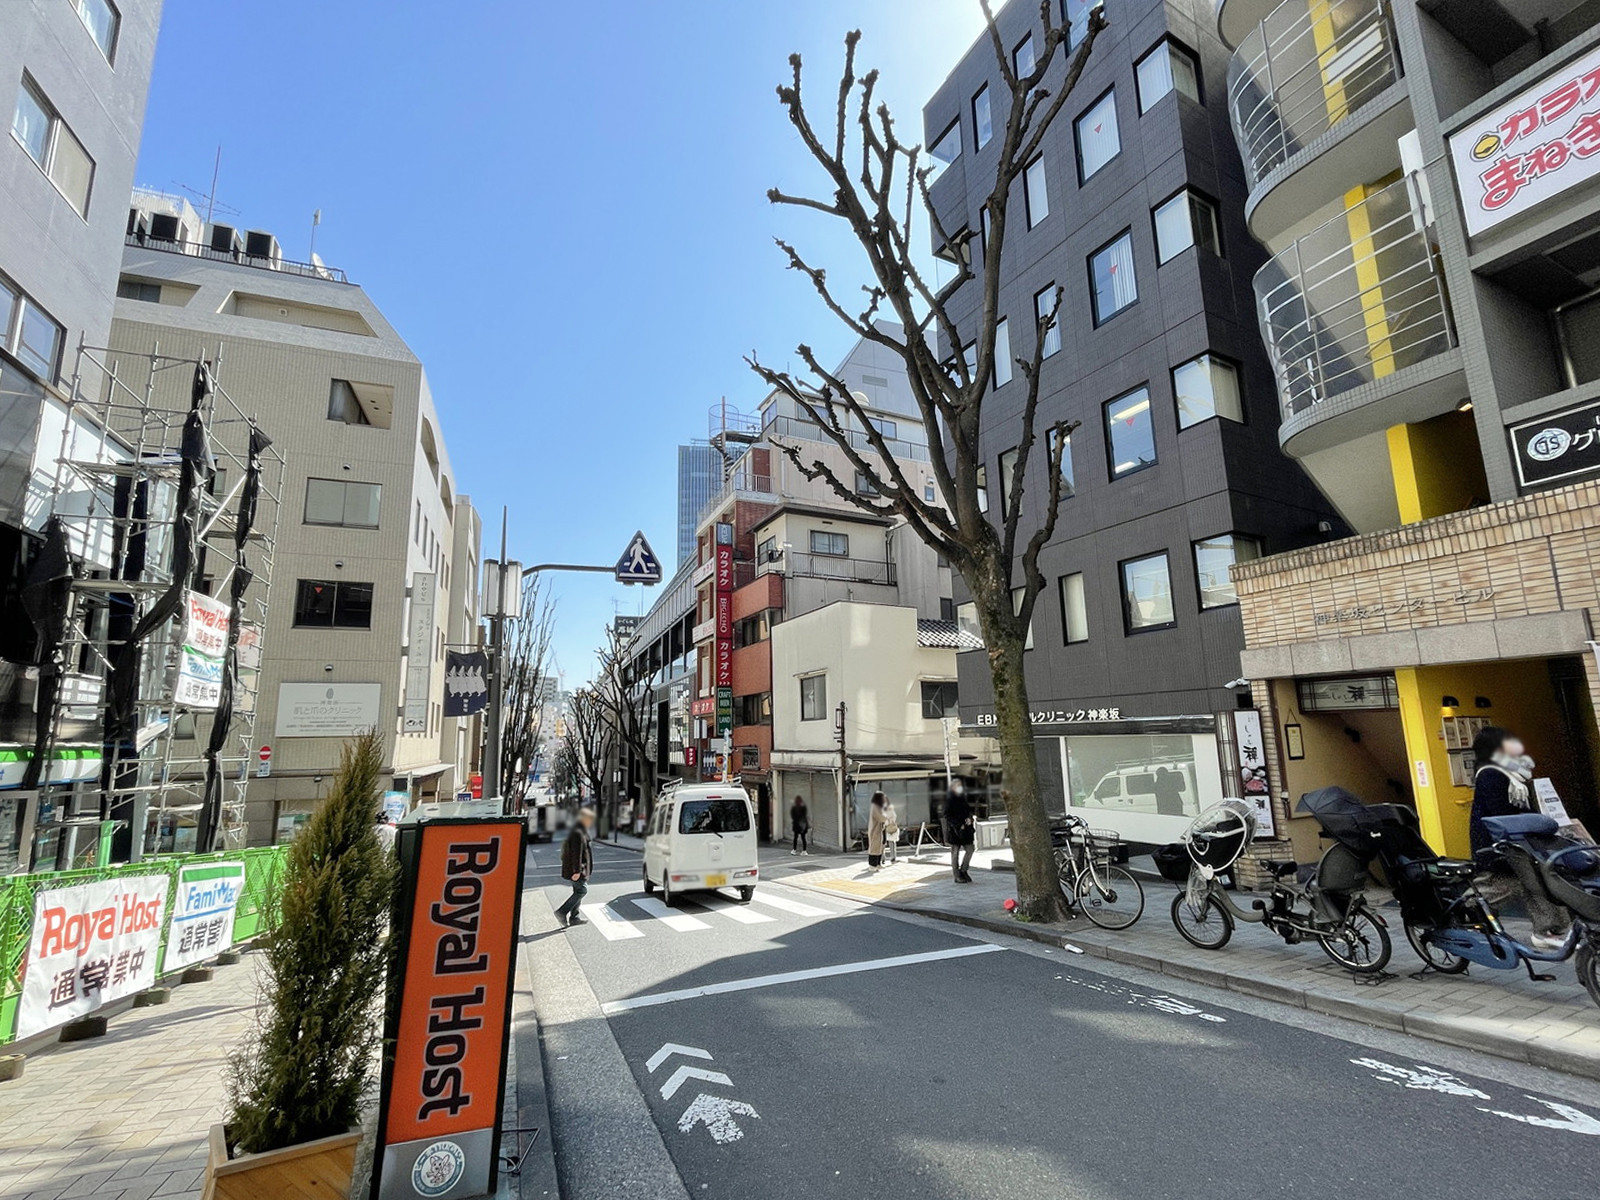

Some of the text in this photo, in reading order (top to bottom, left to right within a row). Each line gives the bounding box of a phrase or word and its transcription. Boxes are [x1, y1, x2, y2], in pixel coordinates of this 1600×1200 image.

[720, 551, 729, 586] カラオケ
[1315, 588, 1496, 626] 神楽坂センタービル
[720, 642, 729, 680] カラオケ
[39, 892, 161, 958] Roya Host
[430, 836, 500, 977] Royal
[417, 985, 486, 1121] Host
